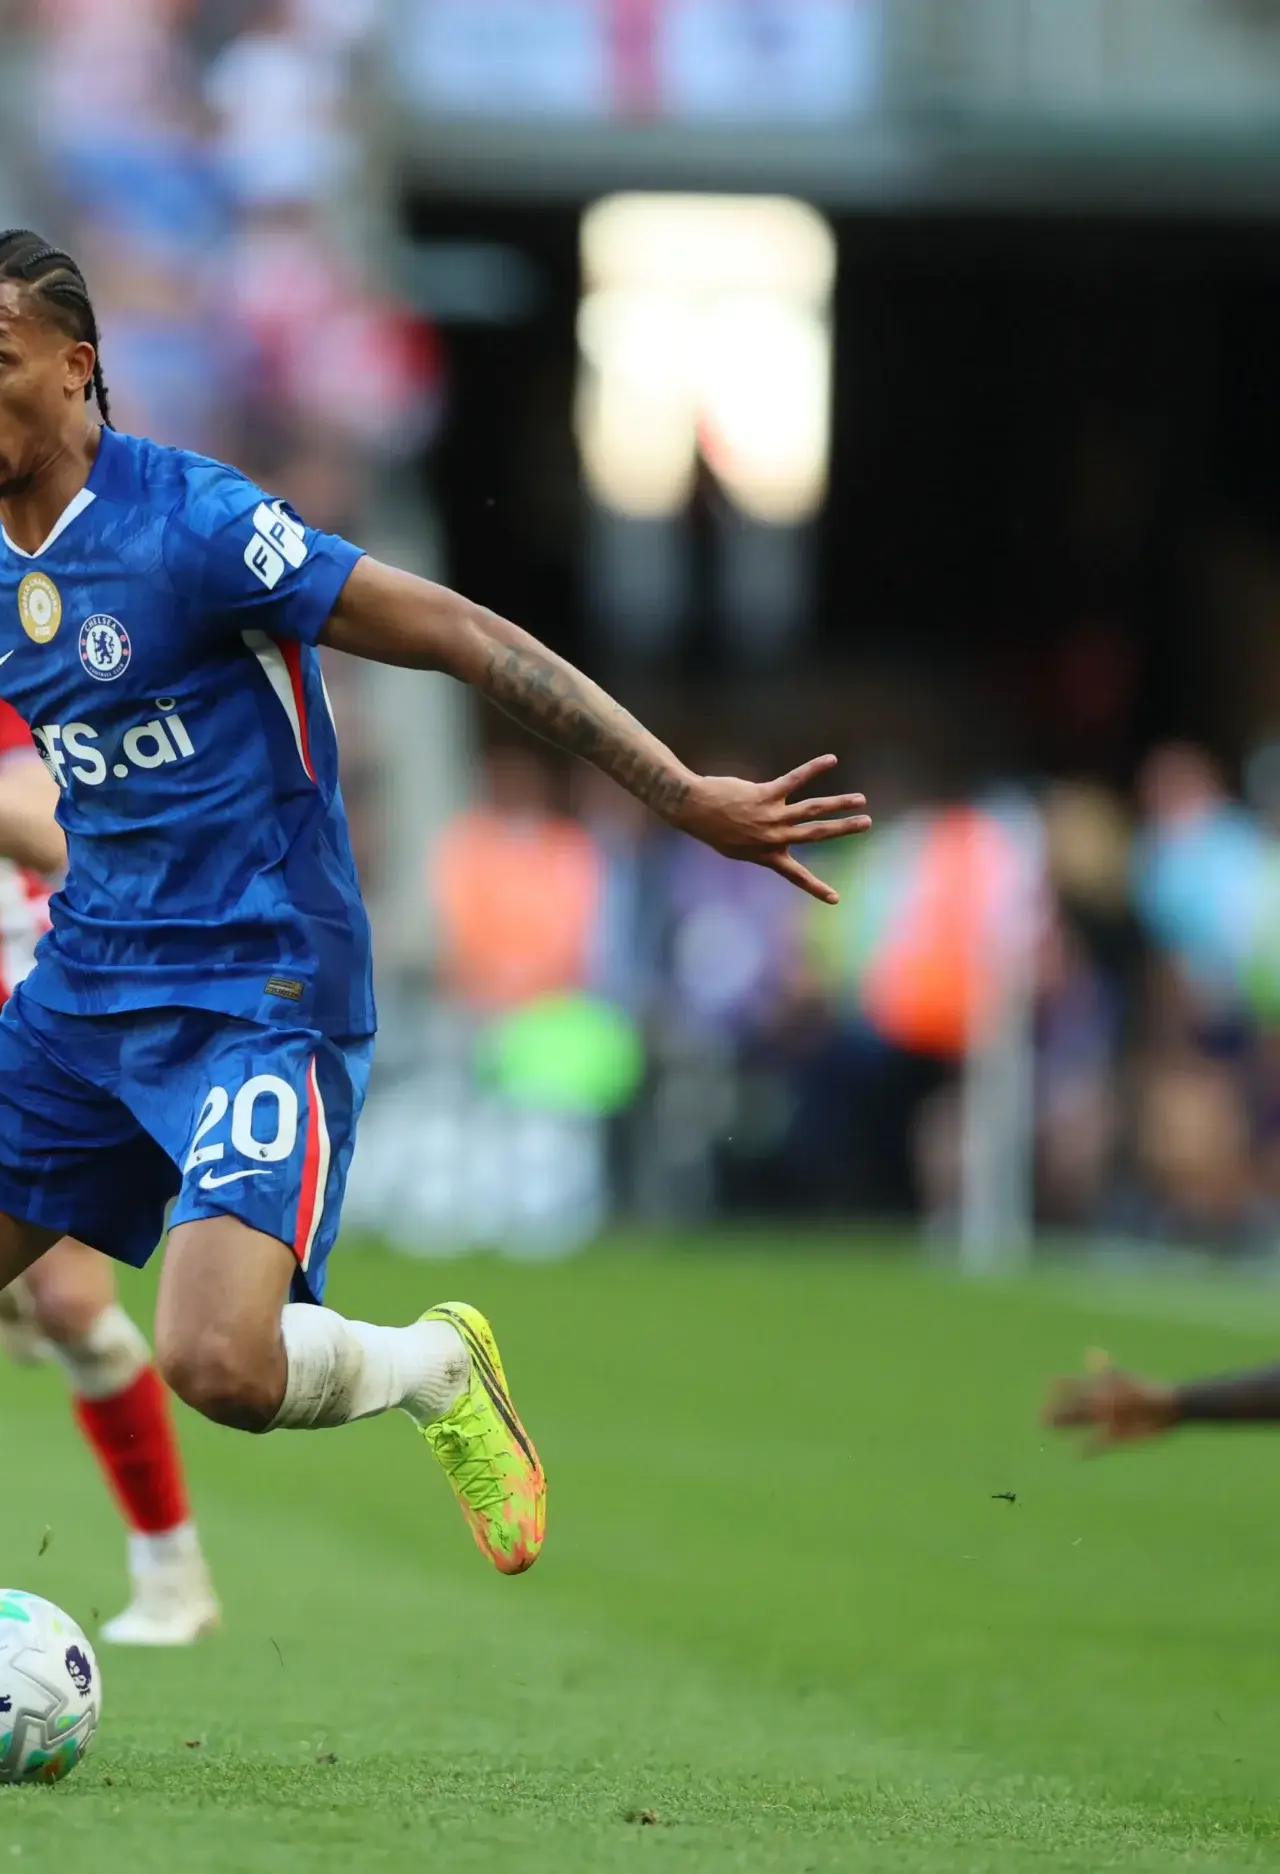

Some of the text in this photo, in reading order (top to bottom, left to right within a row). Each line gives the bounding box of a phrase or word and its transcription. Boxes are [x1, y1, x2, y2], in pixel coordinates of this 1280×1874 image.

[84, 616, 117, 633] CHELSEA
[32, 697, 195, 788] FS.ai
[183, 1074, 298, 1174] 20
